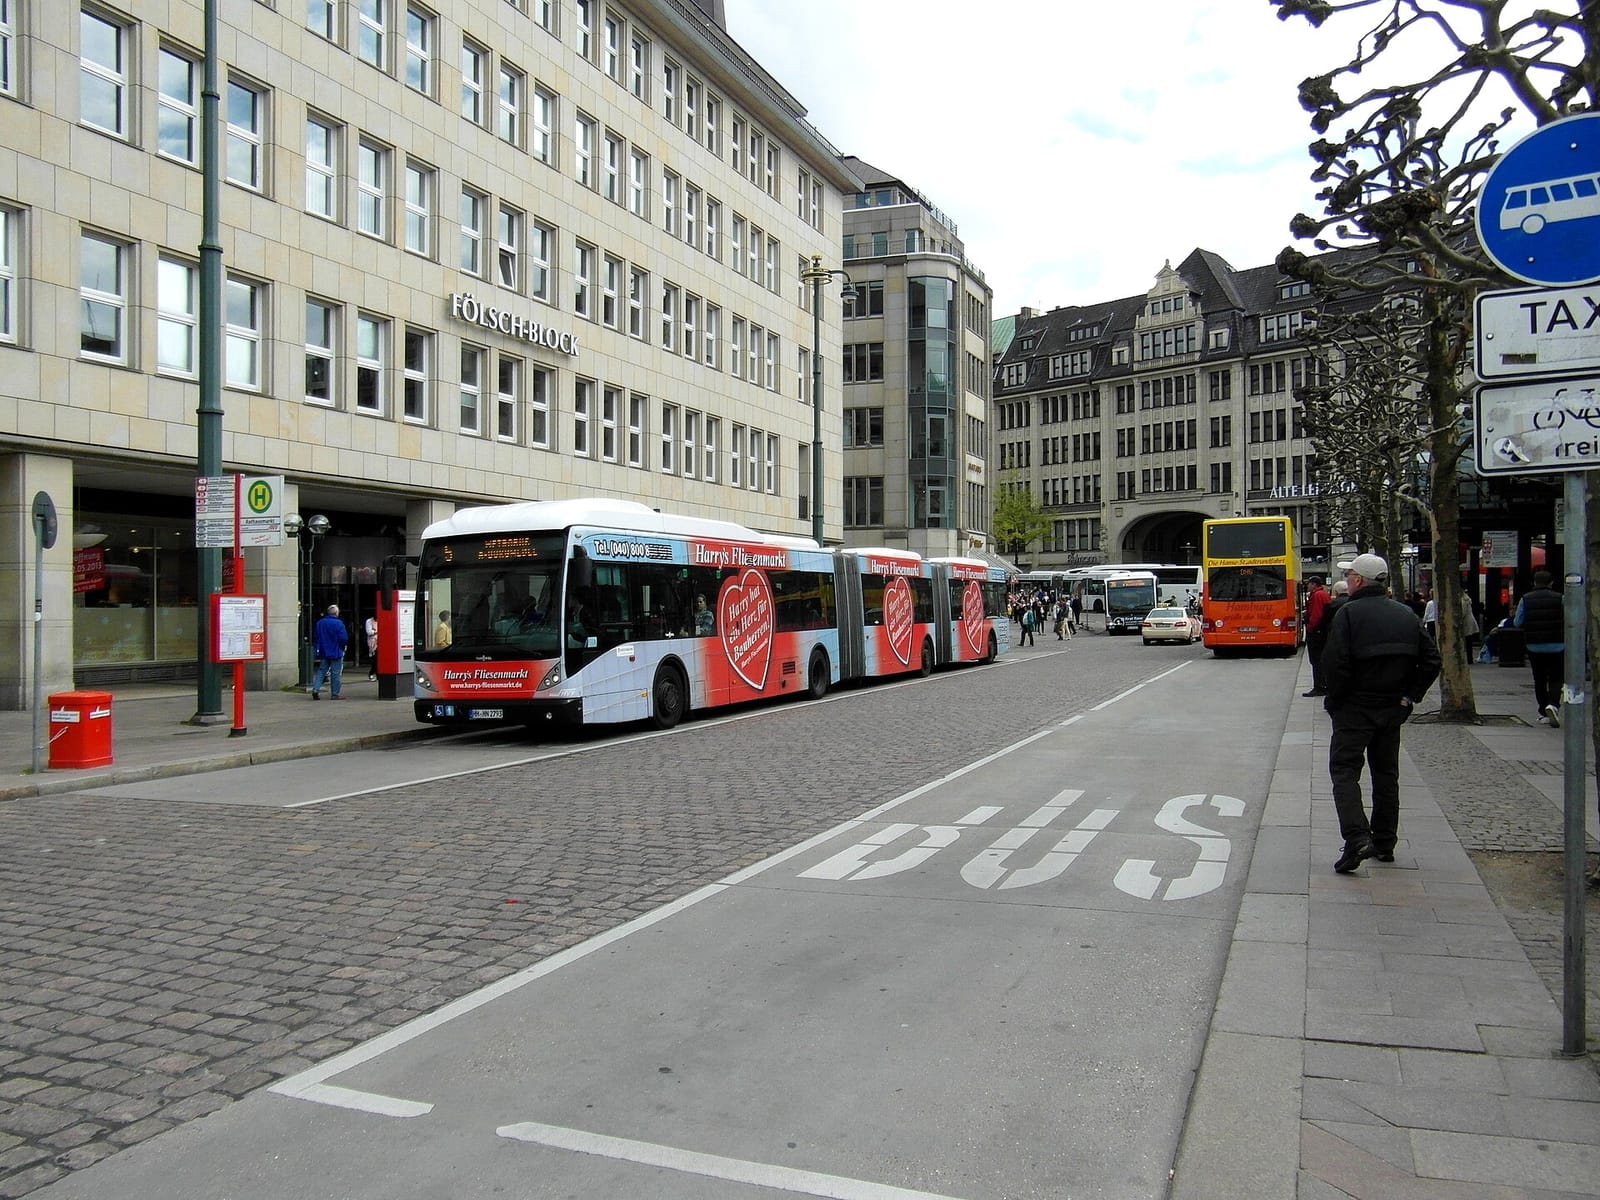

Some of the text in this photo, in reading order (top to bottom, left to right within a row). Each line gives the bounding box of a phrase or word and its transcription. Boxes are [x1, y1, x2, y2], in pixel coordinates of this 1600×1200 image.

[450, 292, 580, 356] FÖLSCH-BLOCK
[1269, 485, 1298, 499] ALTE
[594, 540, 610, 555] Tel.
[610, 541, 630, 558] (040)
[695, 544, 729, 569] Harry's
[728, 595, 749, 622] Harry
[741, 611, 757, 633] Herz
[444, 669, 528, 681] Harry's Fliesenmarkt
